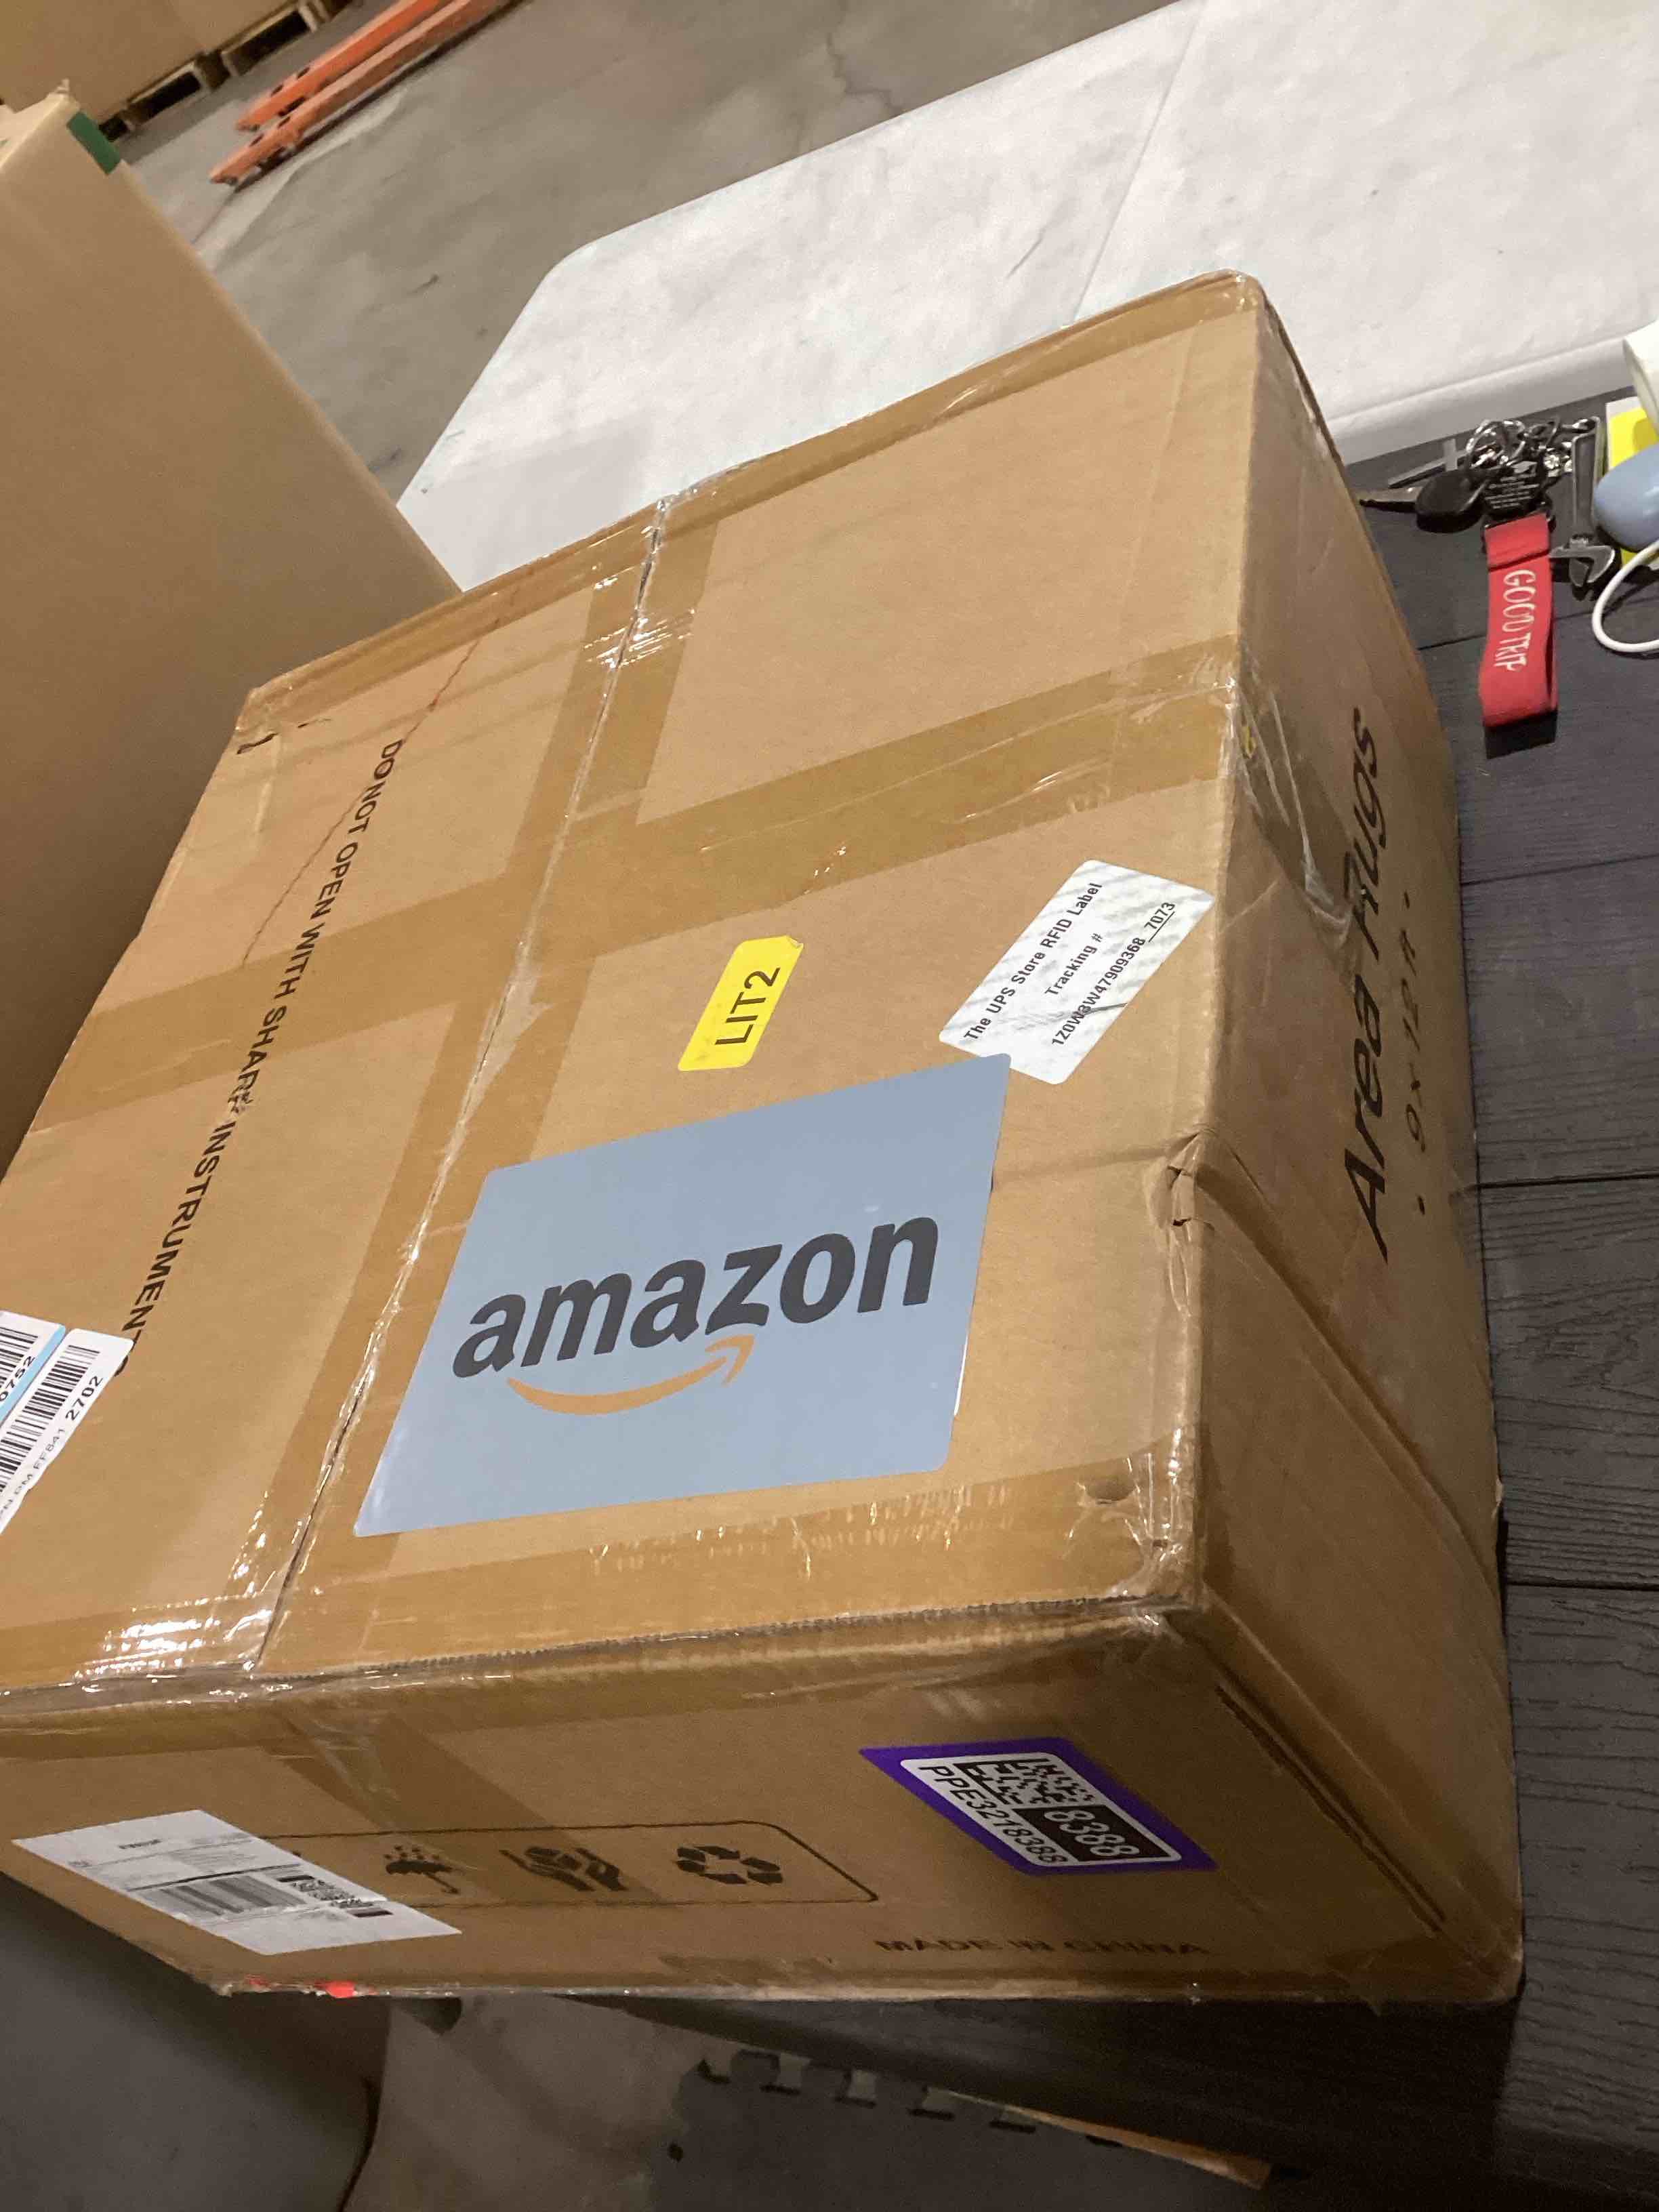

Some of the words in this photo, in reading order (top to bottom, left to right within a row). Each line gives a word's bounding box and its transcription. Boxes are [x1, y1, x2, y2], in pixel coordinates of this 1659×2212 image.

[374, 739, 403, 779] DO
[347, 780, 386, 835] NOT
[1345, 706, 1389, 962] Rugs
[310, 842, 359, 920] OPEN
[273, 922, 326, 1000] WITH
[964, 1017, 991, 1041] The
[986, 987, 1016, 1015] UPS
[1011, 951, 1045, 987] Store
[1040, 918, 1072, 948] RFID
[1068, 882, 1103, 916] Label
[1044, 945, 1098, 996] Tracking
[1091, 933, 1103, 943] #
[715, 966, 781, 1046] LIT2
[1344, 973, 1389, 1265] Area
[452, 1216, 939, 1378] amazon
[65, 1375, 104, 1422] 2702
[1044, 1809, 1140, 1857] 8388
[874, 1939, 1003, 1952] MADE
